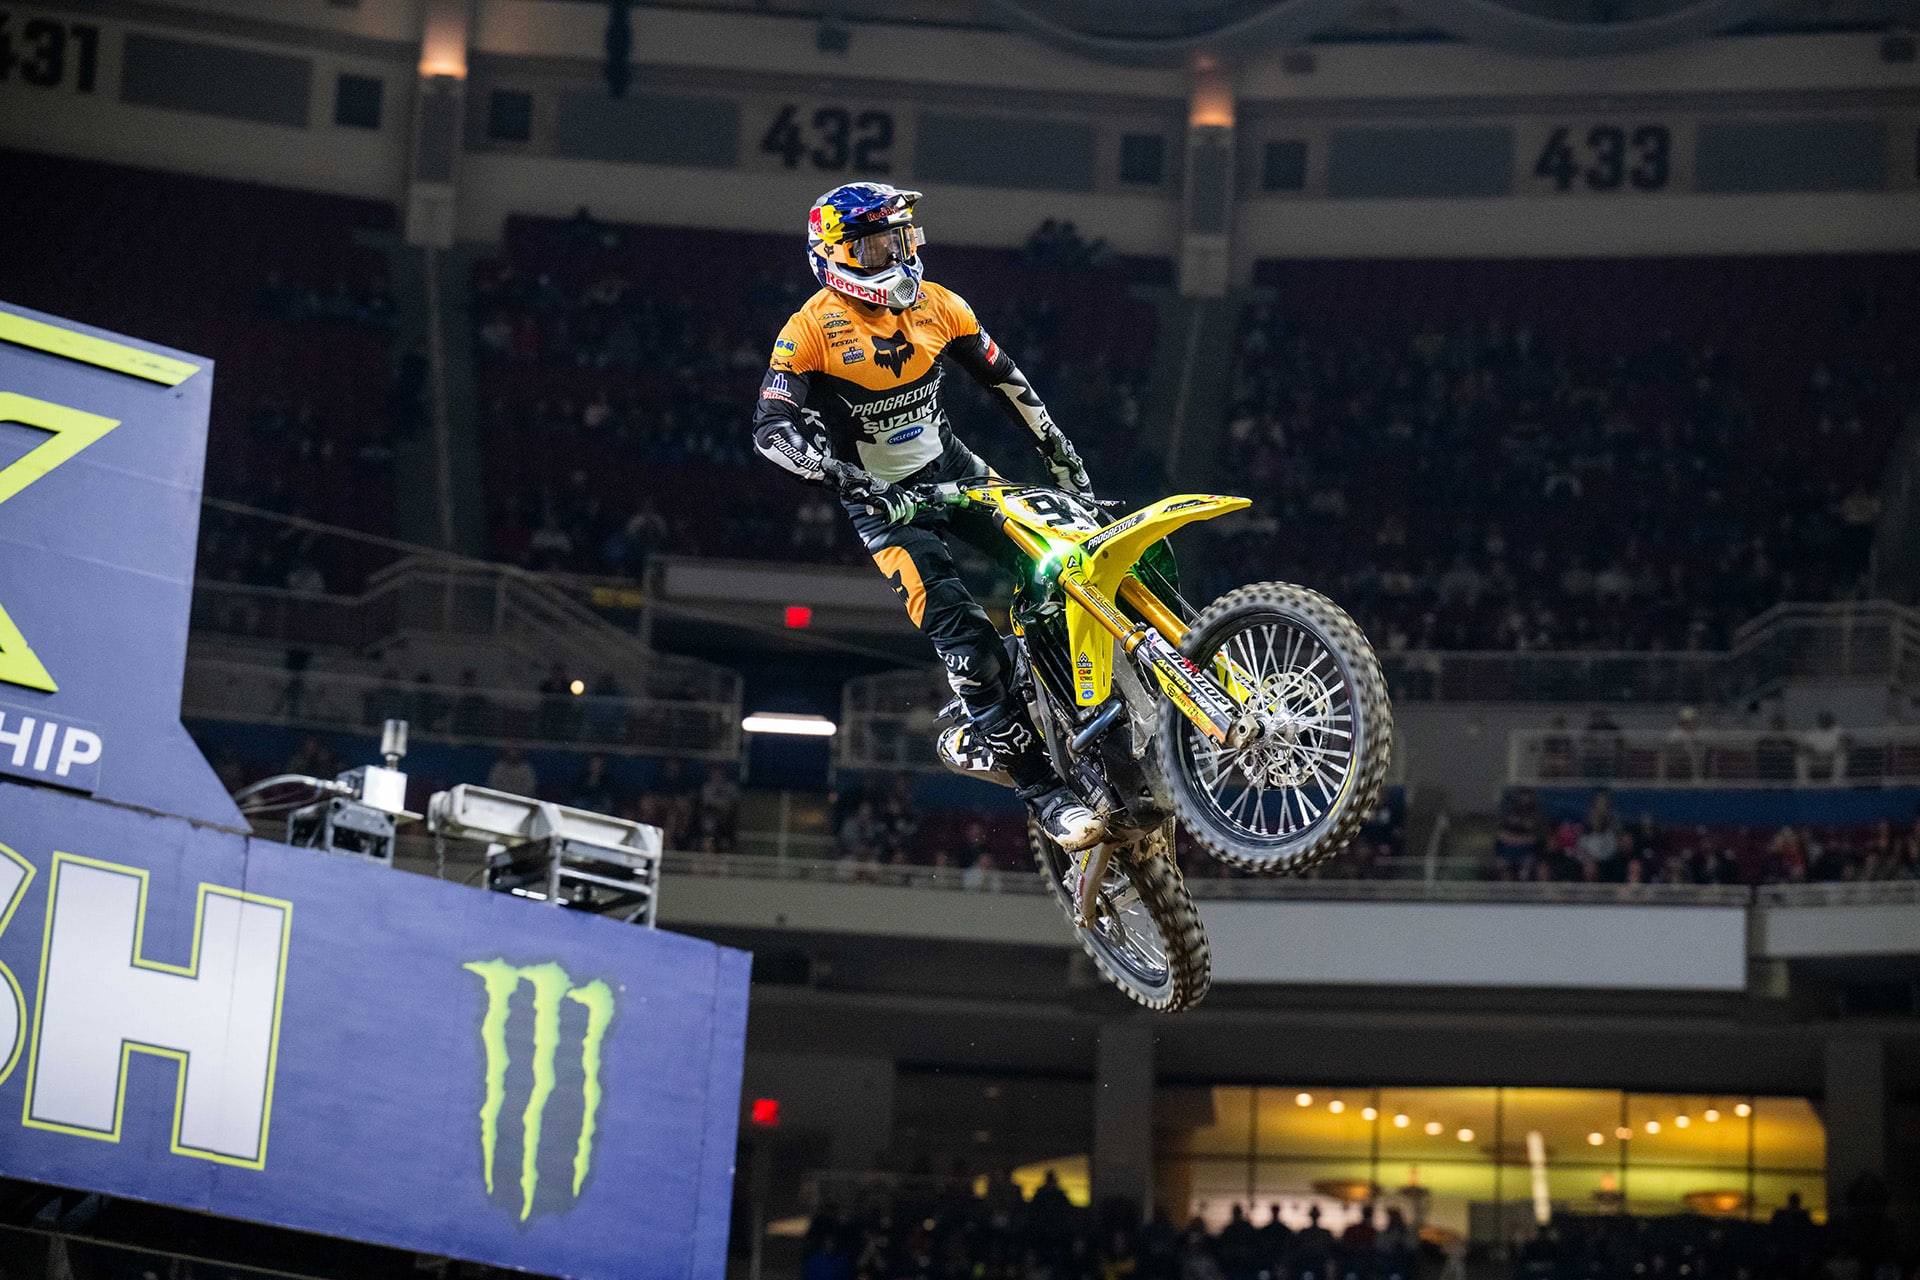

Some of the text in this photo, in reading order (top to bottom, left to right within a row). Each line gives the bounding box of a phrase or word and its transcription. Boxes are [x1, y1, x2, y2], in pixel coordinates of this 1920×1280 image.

[762, 105, 894, 171] 432
[1536, 126, 1672, 193] 433
[851, 378, 941, 417] PROGRESSIVE
[863, 398, 938, 435] SUZUKI
[1087, 516, 1138, 550] PROGRESSIVE
[1166, 651, 1230, 705] DUNLOP
[0, 711, 102, 777] HIP
